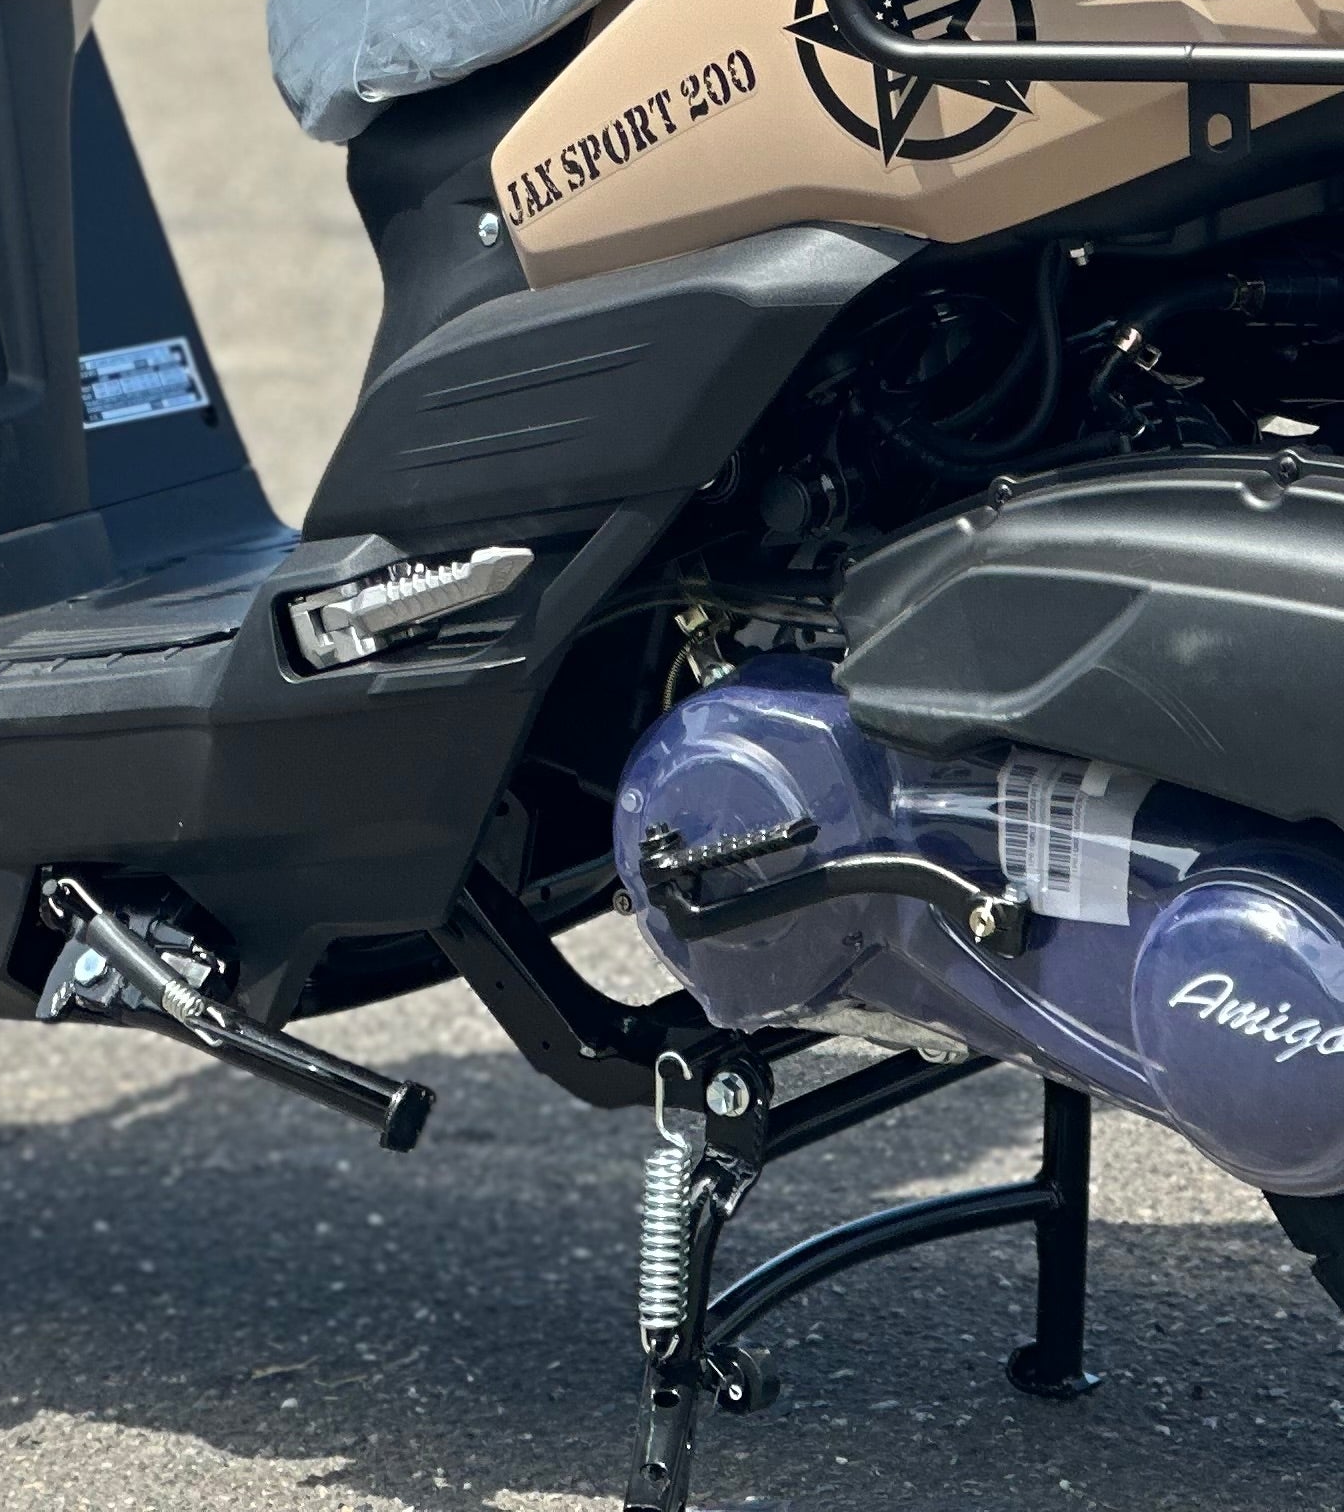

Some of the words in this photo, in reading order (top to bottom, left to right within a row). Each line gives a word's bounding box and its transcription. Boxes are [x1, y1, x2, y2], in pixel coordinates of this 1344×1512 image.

[507, 157, 563, 226] JAX
[560, 88, 677, 192] SPORT
[680, 49, 757, 122] 200
